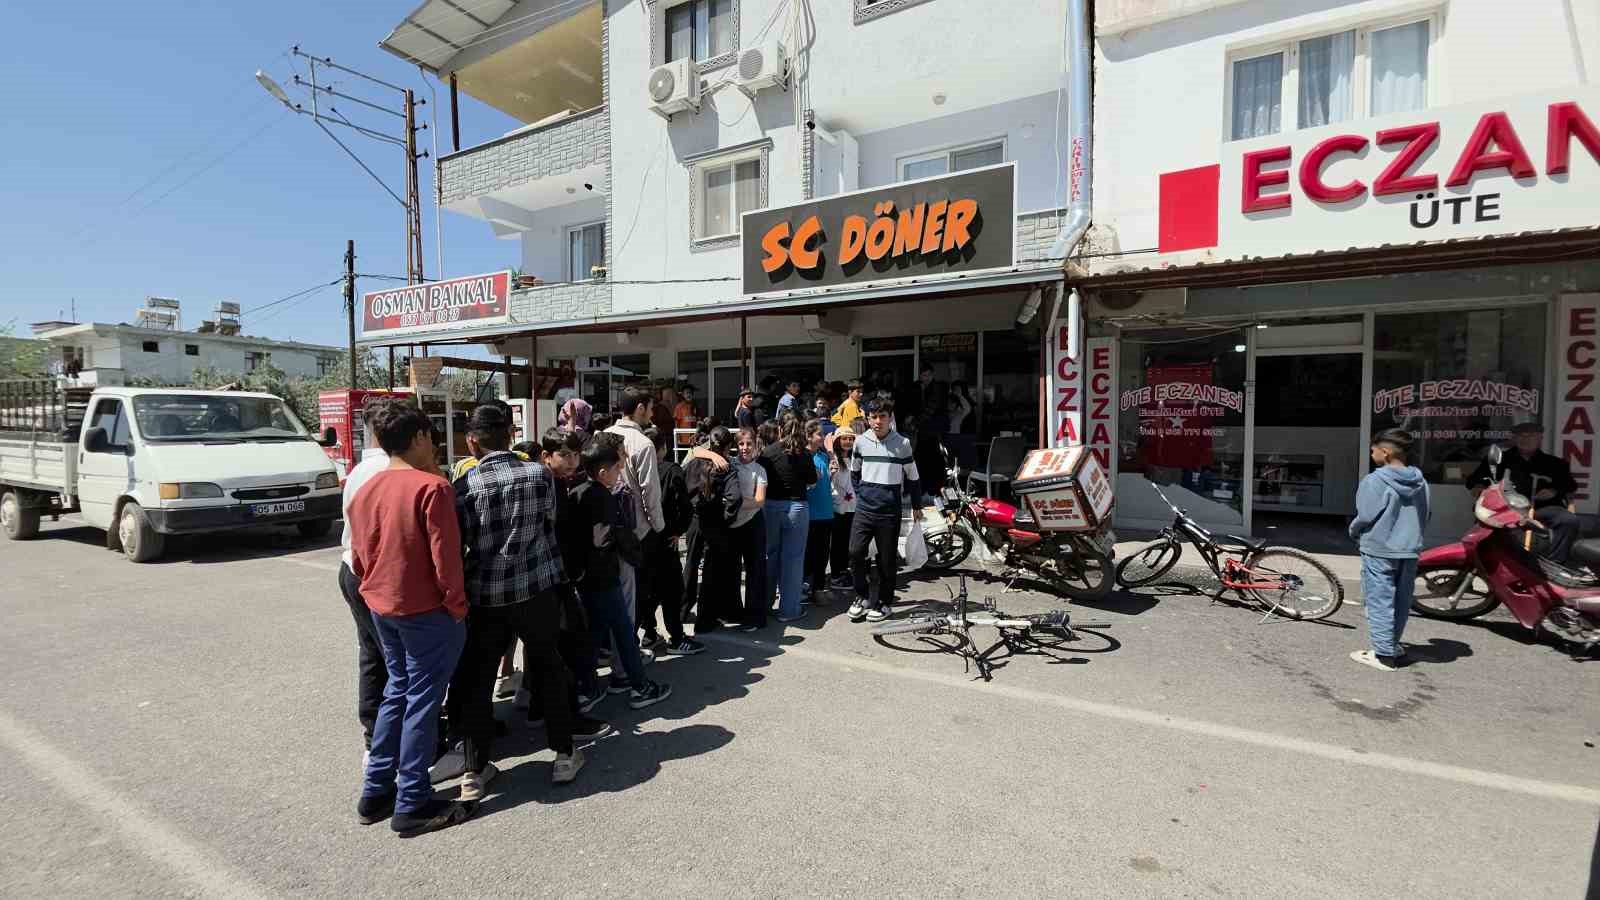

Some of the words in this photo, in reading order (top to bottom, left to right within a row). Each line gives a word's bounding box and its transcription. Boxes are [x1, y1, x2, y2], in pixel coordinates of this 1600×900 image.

[1242, 101, 1600, 213] ECZAN
[1409, 192, 1501, 228] ÜTE
[761, 216, 823, 275] SC
[839, 199, 978, 266] DÖNER
[372, 287, 426, 319] OSMAN
[430, 278, 497, 310] BAKKAL
[1120, 386, 1152, 411] ÜTE
[1375, 385, 1414, 413] ÜTE
